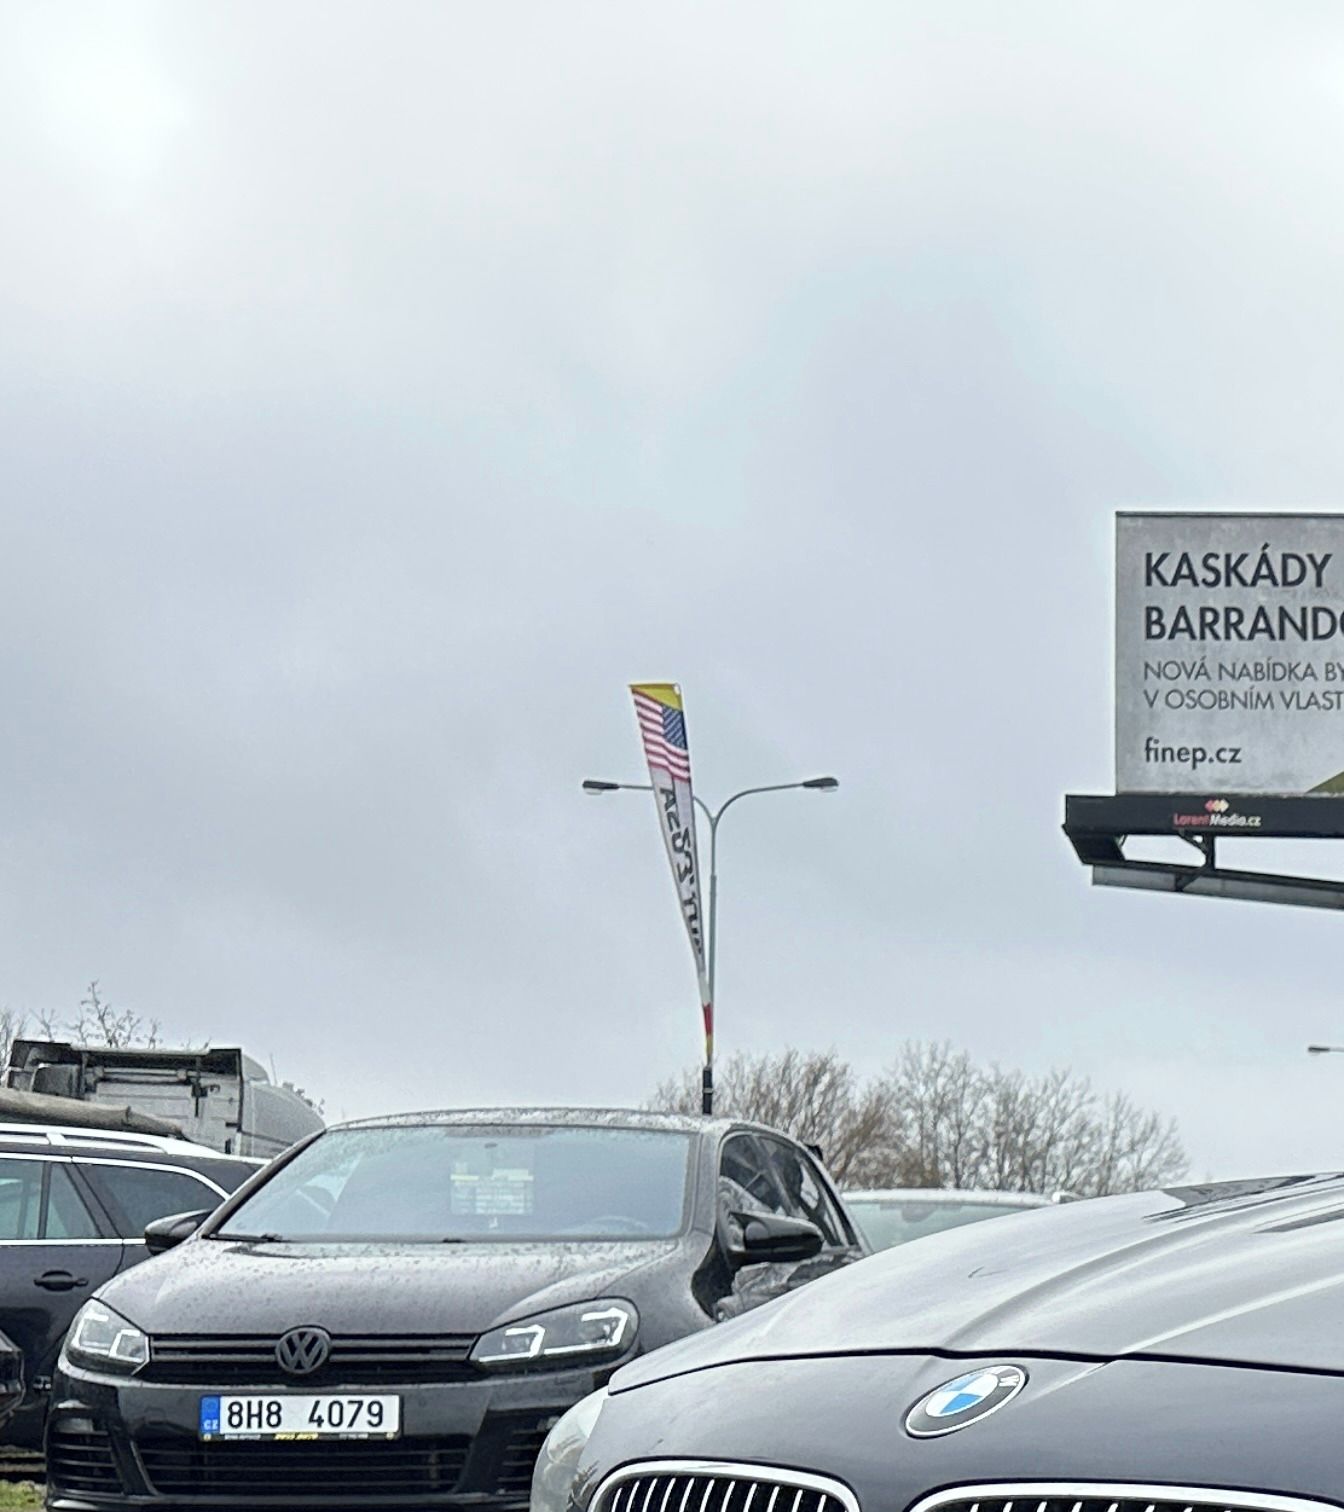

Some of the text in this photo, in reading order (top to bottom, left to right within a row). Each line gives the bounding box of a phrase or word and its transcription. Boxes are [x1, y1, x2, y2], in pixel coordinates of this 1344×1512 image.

[1144, 542, 1333, 588] KASKÁDY
[1143, 655, 1211, 682] NOVÁ
[1218, 656, 1318, 682] NABÍDKA
[1143, 688, 1160, 709] V
[1164, 685, 1274, 711] OSOBNÍM
[1144, 736, 1243, 770] finep.cz
[227, 1400, 384, 1429] 8H8 4079
